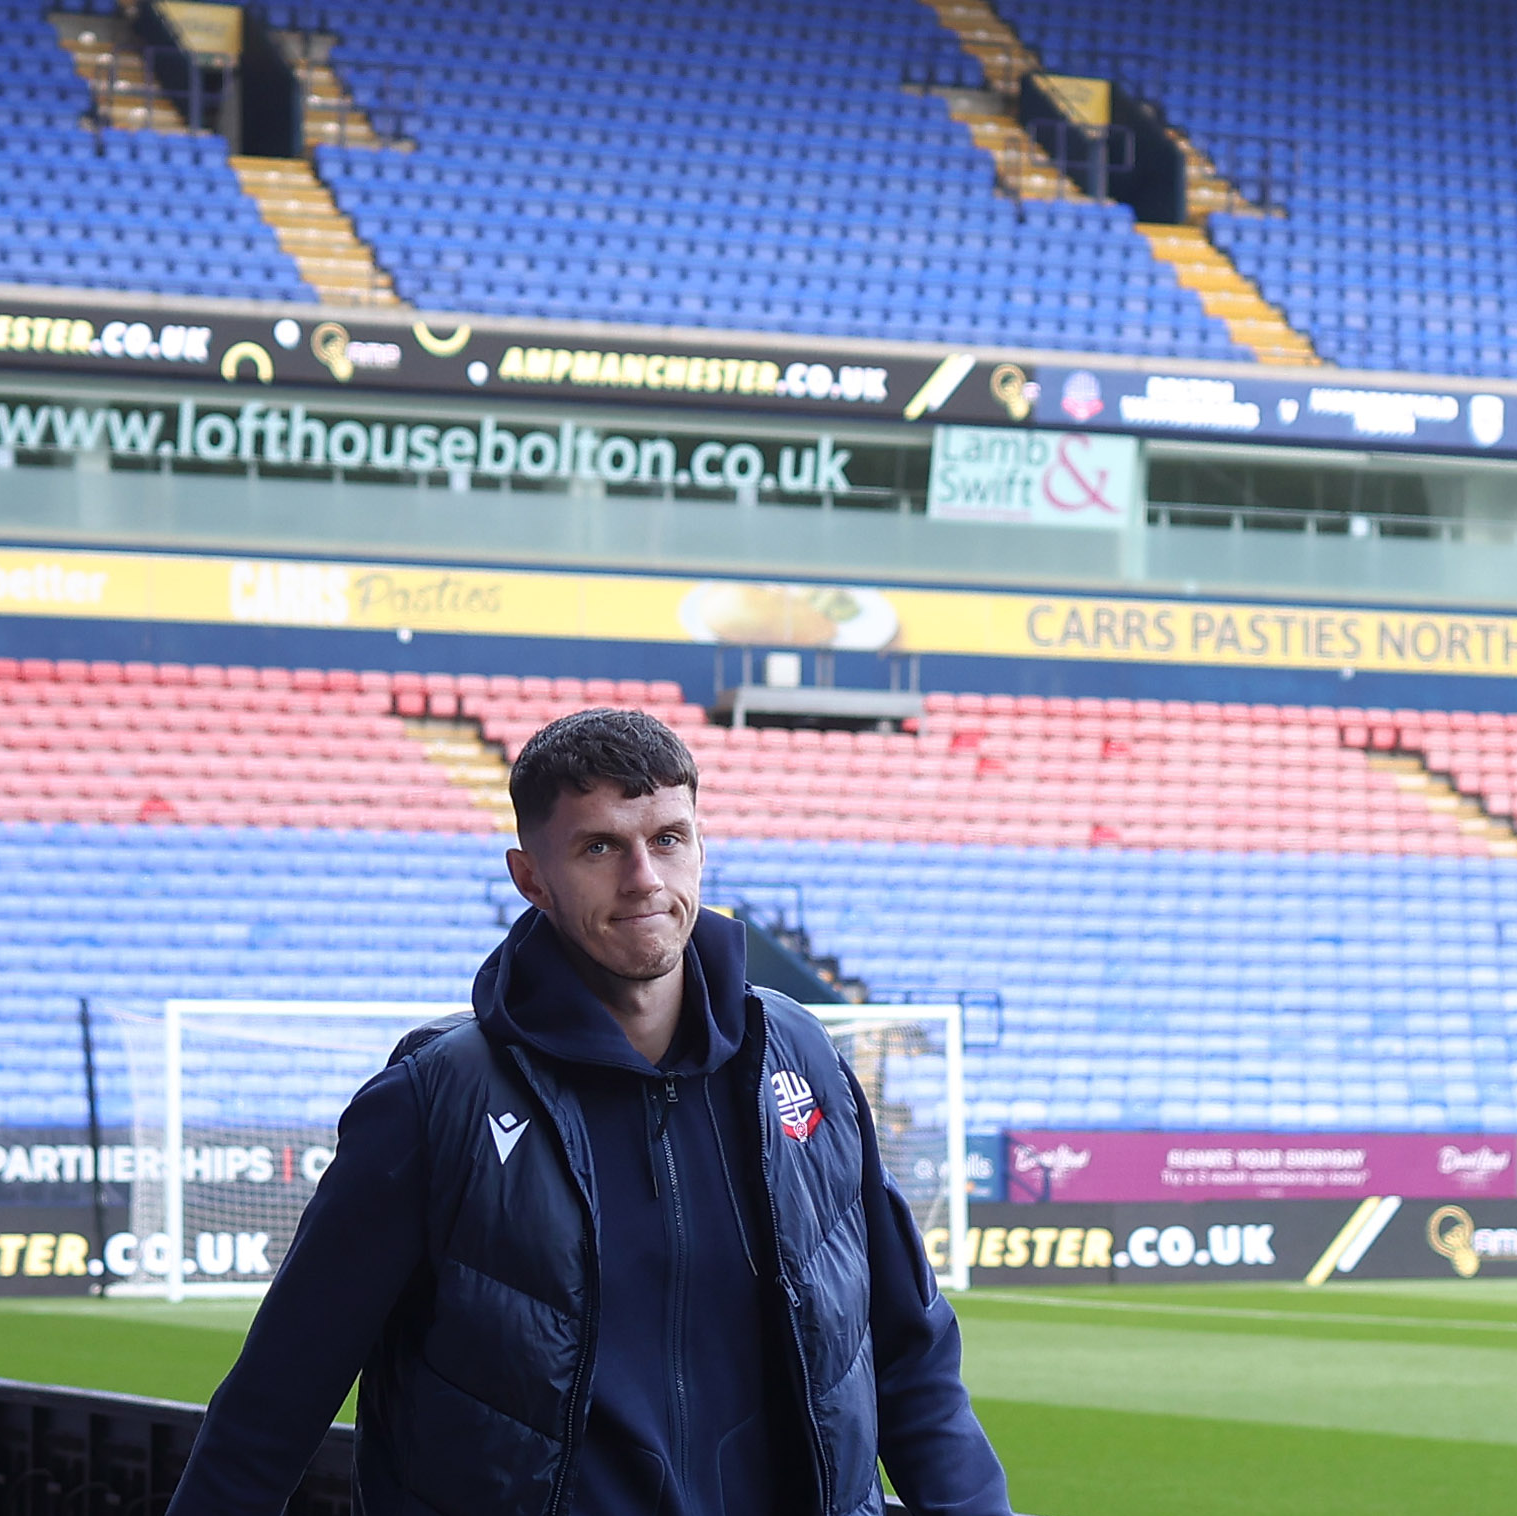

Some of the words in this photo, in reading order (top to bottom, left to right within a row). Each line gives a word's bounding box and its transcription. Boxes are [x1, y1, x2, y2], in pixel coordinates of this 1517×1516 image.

[497, 345, 888, 402] AMPMANCHESTER.CO.UK
[939, 428, 1050, 468] Lamb
[1042, 433, 1121, 514] &
[940, 465, 1035, 507] Swift
[228, 561, 351, 625] CARRS
[354, 574, 503, 617] Pasties
[1026, 604, 1174, 651] CARRS
[1191, 611, 1363, 660] PASTIES
